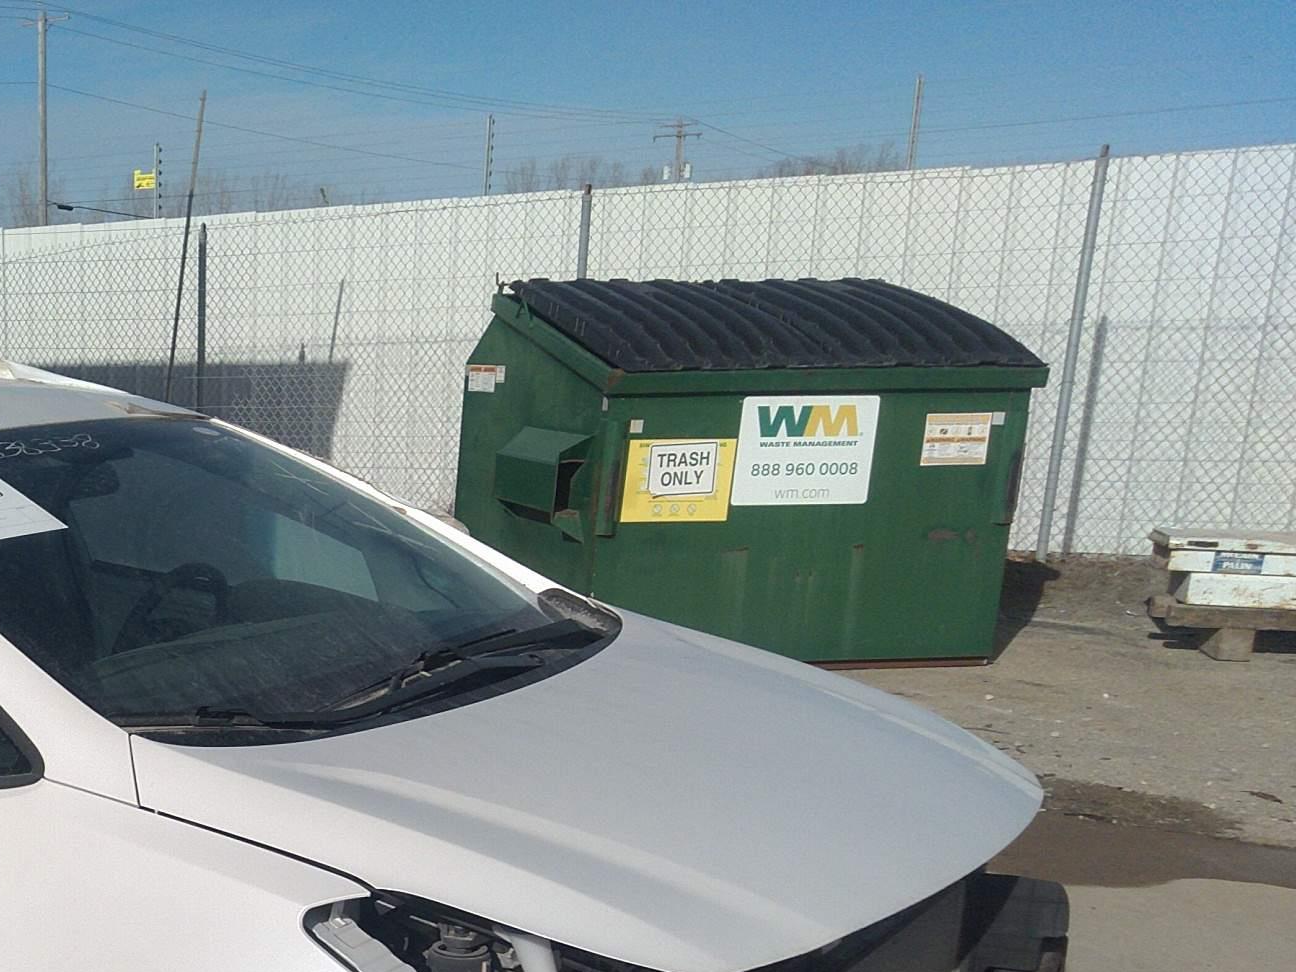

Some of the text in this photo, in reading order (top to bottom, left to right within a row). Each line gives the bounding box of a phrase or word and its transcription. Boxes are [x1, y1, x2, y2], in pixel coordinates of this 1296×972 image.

[757, 404, 859, 438] WM
[793, 440, 860, 448] MANAGEMENT
[657, 451, 711, 468] TRASH
[750, 462, 859, 477] 888 960 0008
[660, 469, 705, 487] ONLY
[774, 487, 831, 499] wm.com
